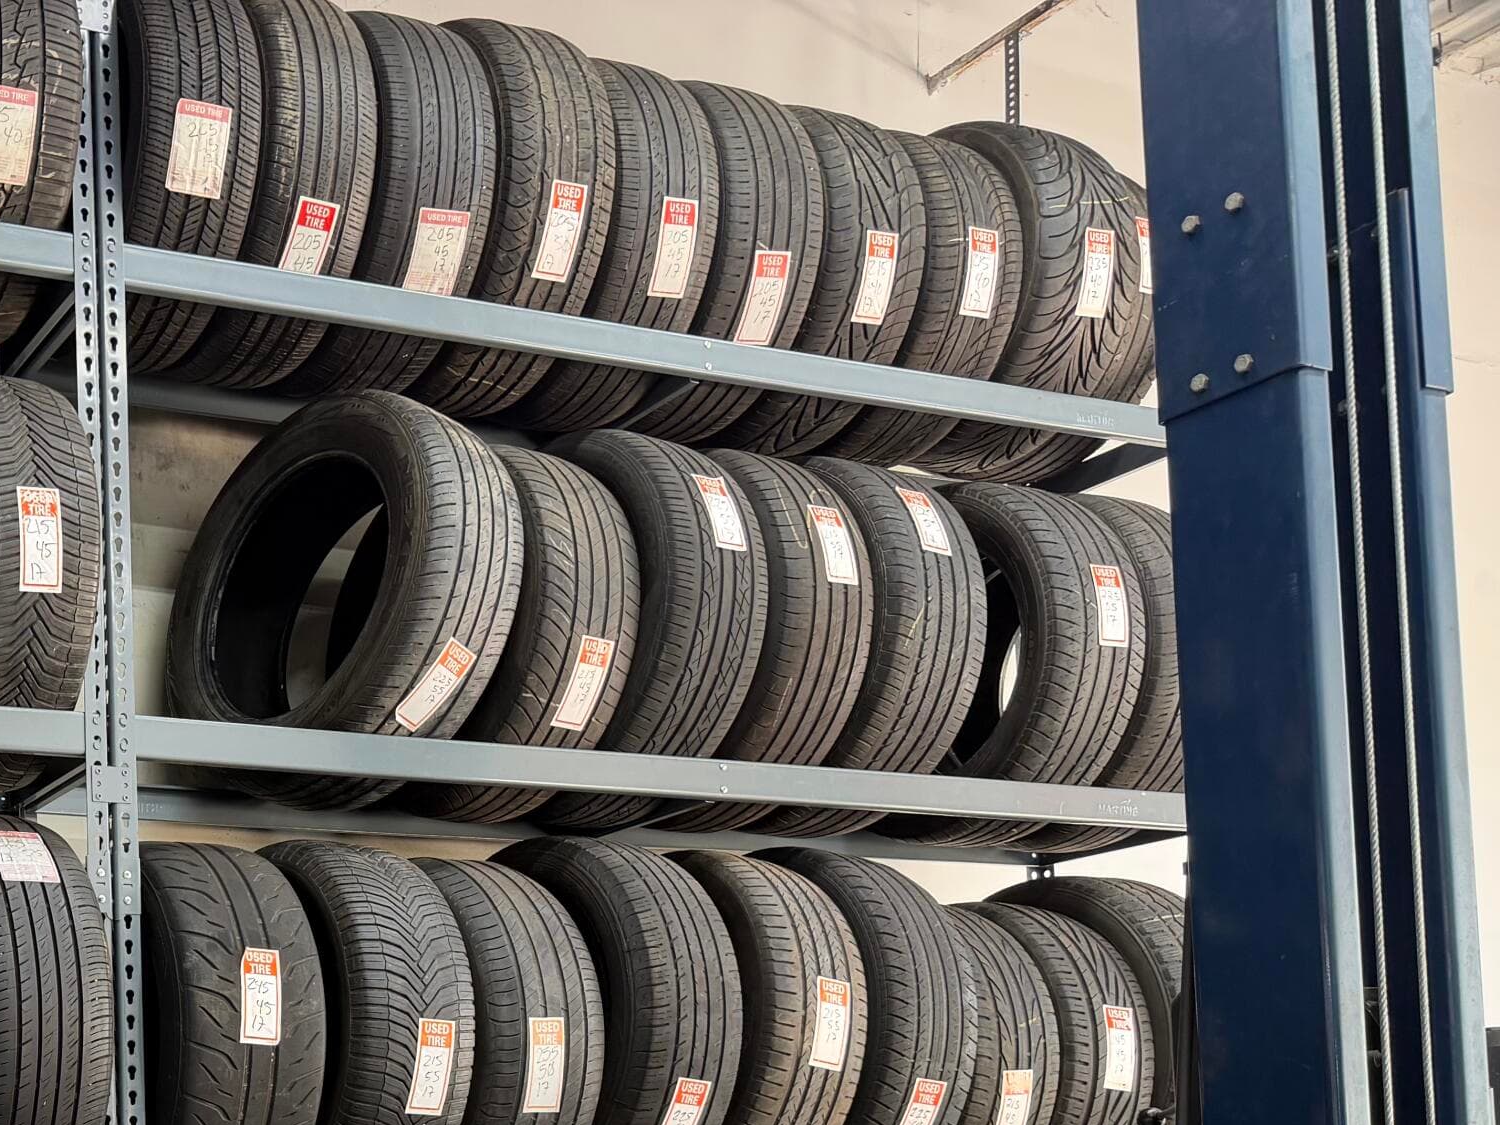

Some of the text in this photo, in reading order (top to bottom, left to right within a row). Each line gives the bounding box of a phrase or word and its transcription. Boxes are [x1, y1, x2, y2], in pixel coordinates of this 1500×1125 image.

[9, 91, 28, 102] TIRE
[556, 185, 580, 197] USED
[559, 198, 577, 210] TIRE
[670, 202, 690, 213] USED
[306, 204, 328, 218] USED
[305, 215, 326, 229] TIRE
[672, 214, 688, 224] TIRE
[872, 234, 893, 246] USED
[973, 231, 993, 241] USED
[1090, 231, 1109, 241] USED
[762, 255, 783, 265] USED
[763, 267, 781, 276] TIRE
[27, 503, 52, 516] TIRE
[35, 542, 54, 560] 45
[448, 646, 467, 666] USED
[246, 951, 273, 962] USED
[249, 964, 273, 975] TIRE
[822, 982, 844, 993] USED
[825, 993, 843, 1003] TIRE
[257, 999, 279, 1015] 45
[252, 1016, 265, 1031] 17
[424, 1022, 449, 1033] USED
[536, 1022, 558, 1031] USED
[427, 1035, 447, 1046] TIRE
[538, 1033, 557, 1044] TIRE
[682, 1081, 705, 1094] USED
[918, 1082, 939, 1094] USED
[680, 1093, 699, 1105] TIRE
[918, 1092, 935, 1104] TIRE
